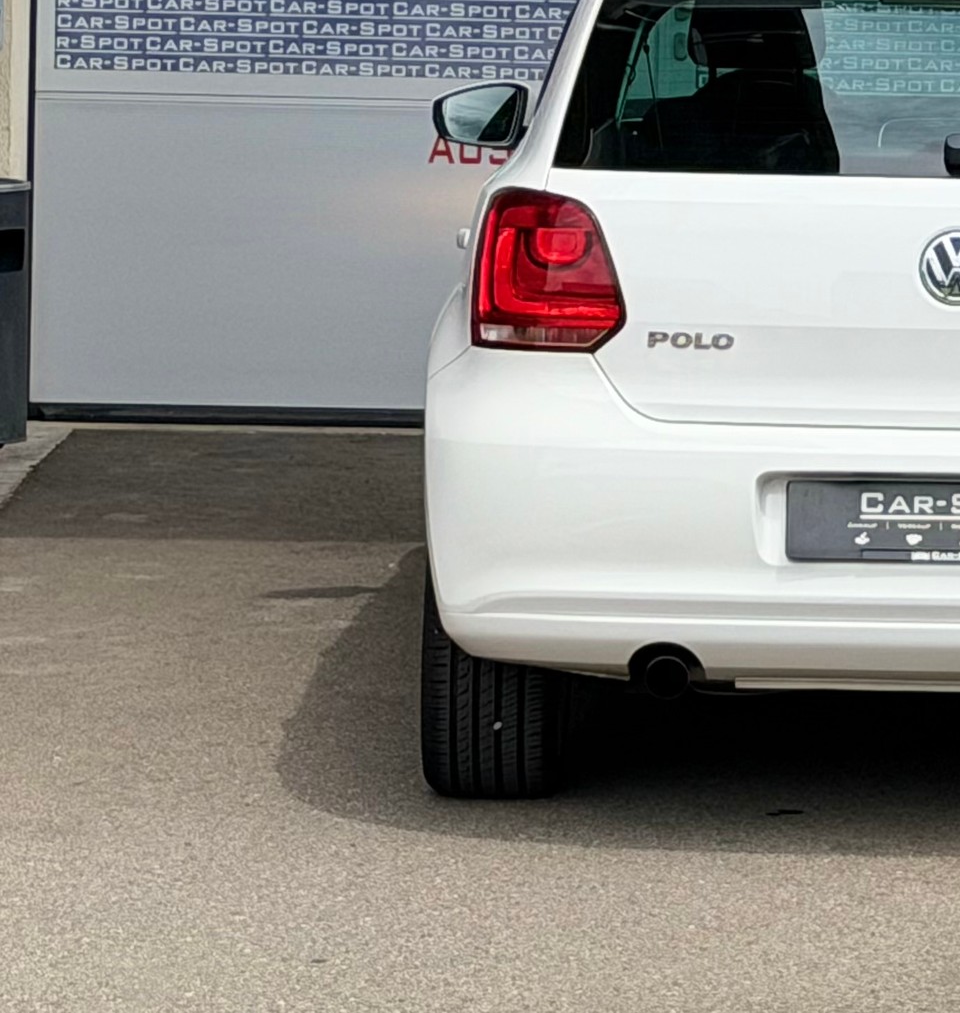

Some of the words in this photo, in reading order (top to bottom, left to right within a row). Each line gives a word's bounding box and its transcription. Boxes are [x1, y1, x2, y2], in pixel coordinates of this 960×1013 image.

[268, 0, 390, 14] CAR-SPOT
[391, 2, 513, 17] CAR-SPOT
[57, 14, 177, 29] CAR-SPOT
[180, 17, 300, 33] CAR-SPOT
[302, 20, 422, 36] CAR-SPOT
[424, 23, 545, 39] CAR-SPOT
[146, 36, 267, 52] CAR-SPOT
[268, 39, 389, 56] CAR-SPOT
[391, 43, 512, 59] CAR-SPOT
[56, 54, 177, 70] CAR-SPOT
[179, 57, 299, 73] CAR-SPOT
[301, 60, 422, 76] CAR-SPOT
[424, 64, 544, 79] CAR-SPOT
[646, 331, 735, 351] POLO
